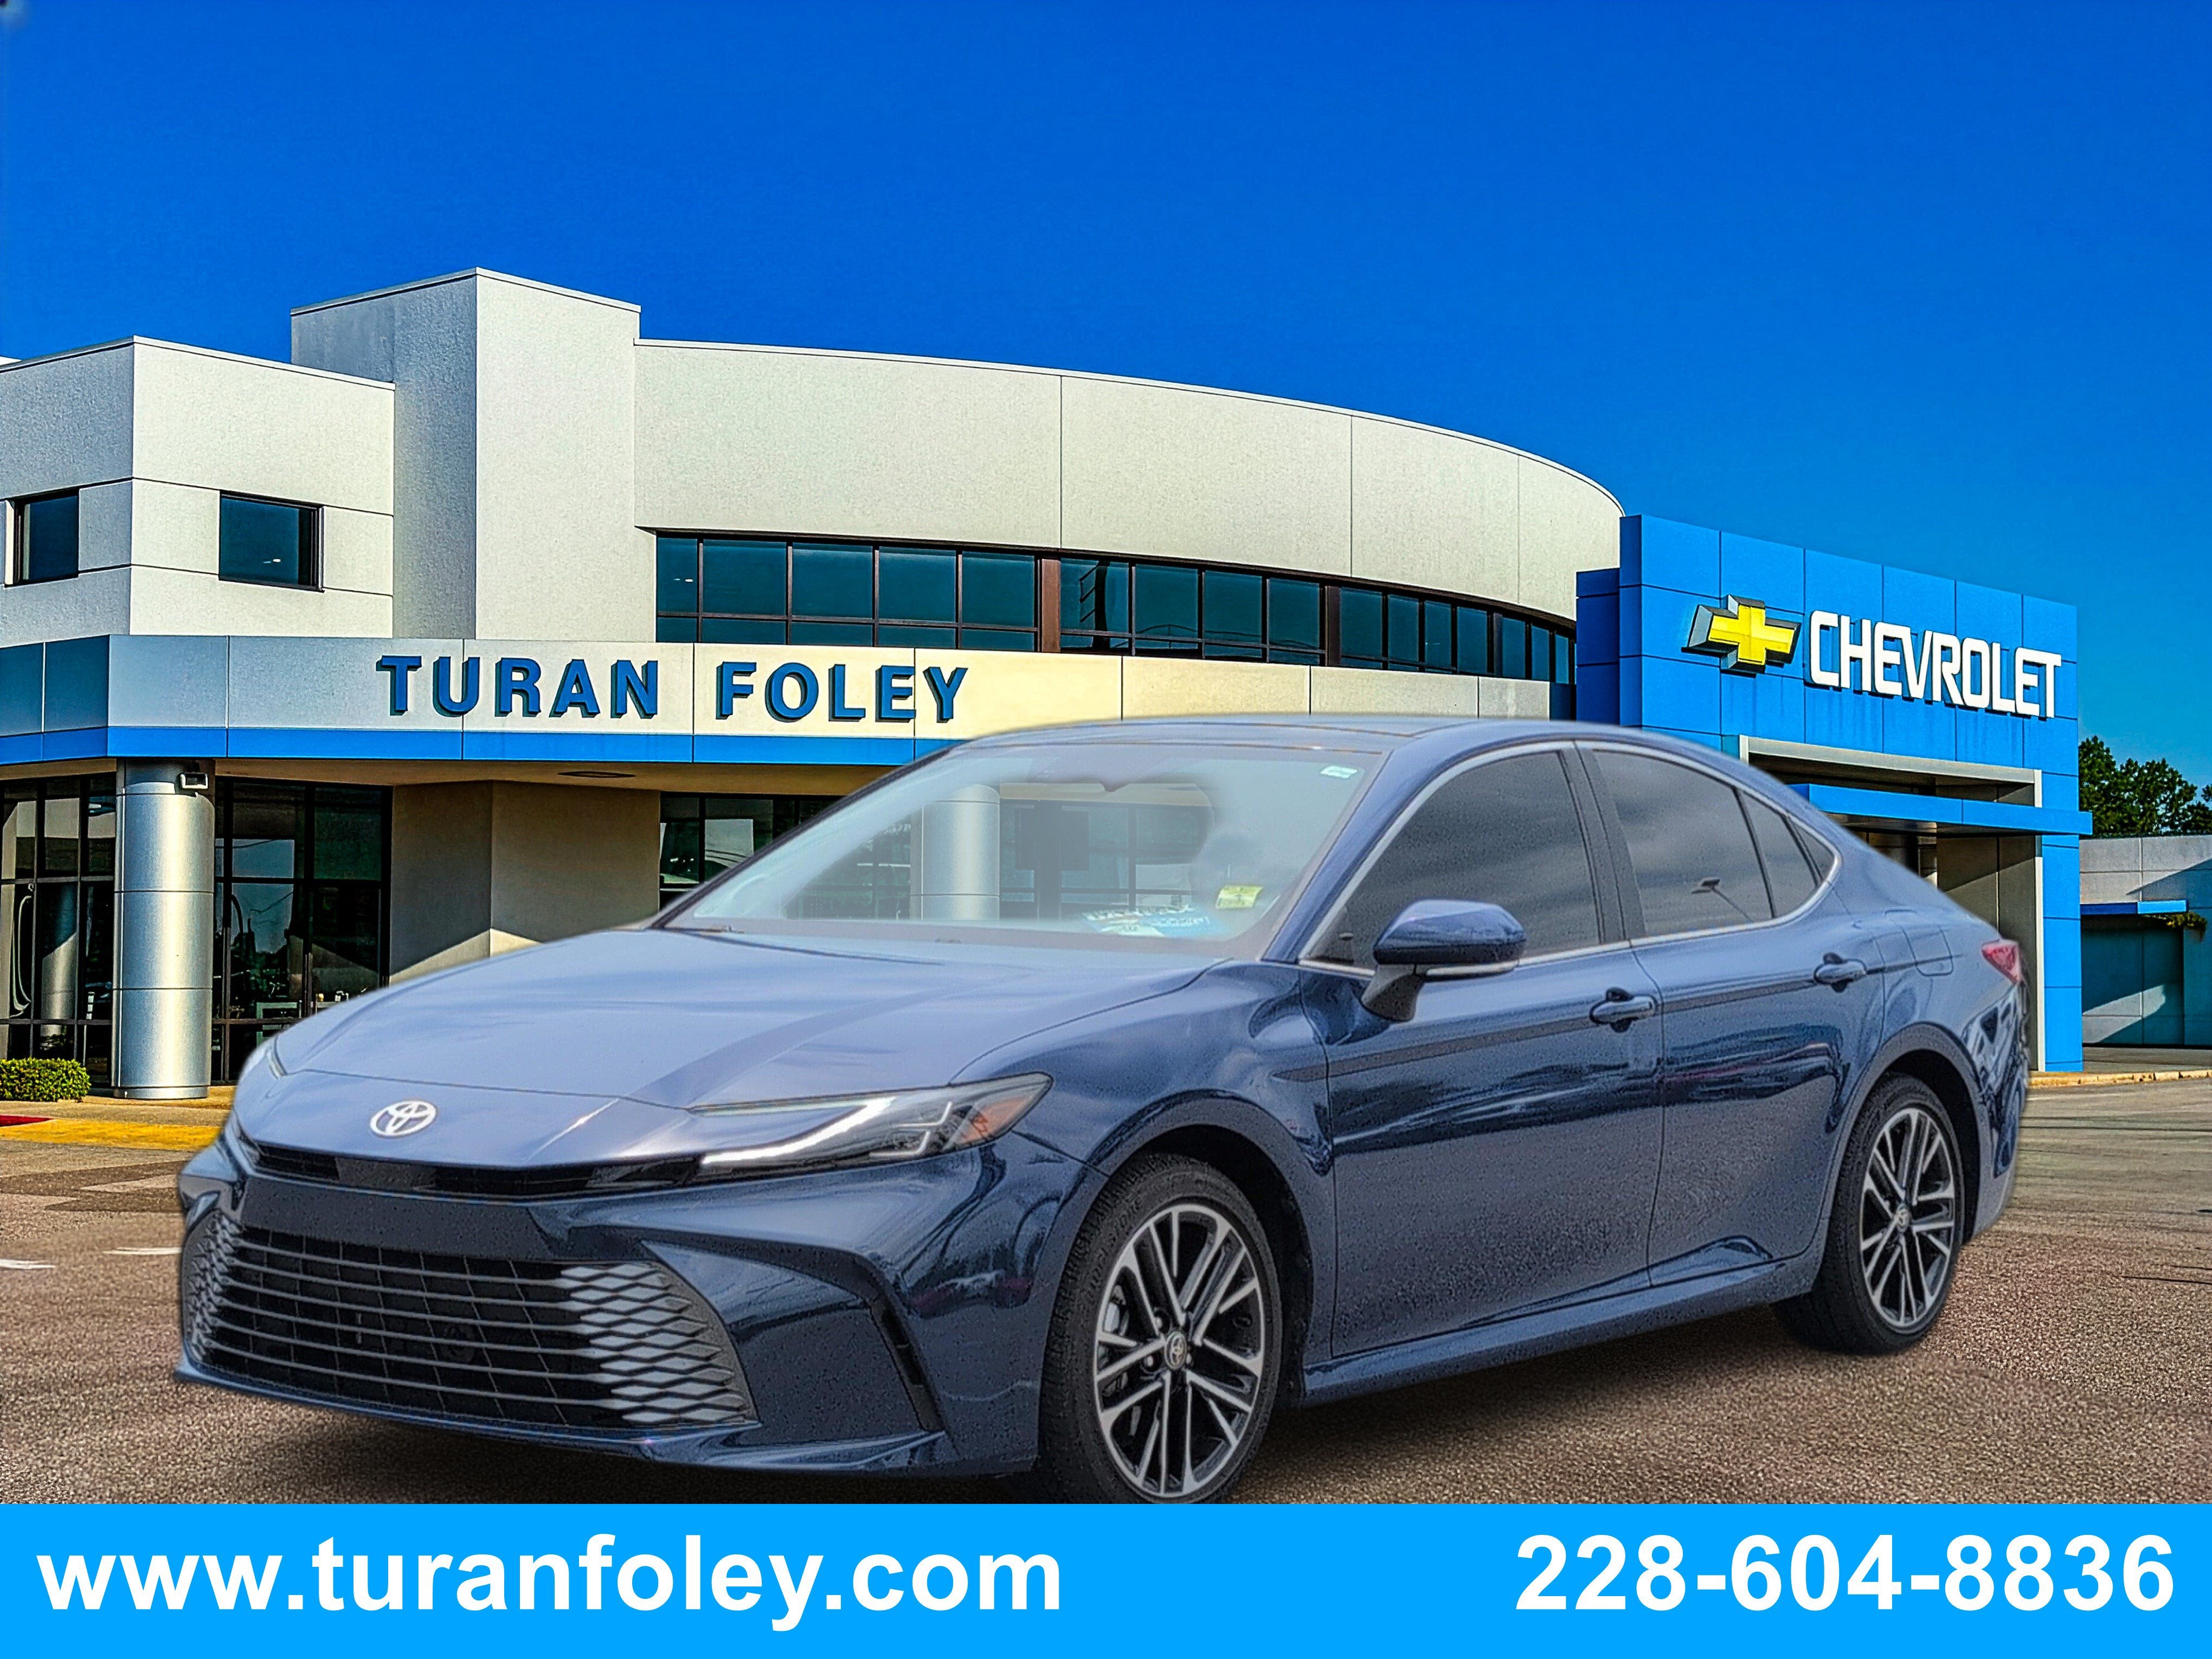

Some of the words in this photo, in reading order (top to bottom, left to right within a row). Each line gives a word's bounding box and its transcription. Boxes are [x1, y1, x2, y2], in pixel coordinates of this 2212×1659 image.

[376, 655, 659, 718] TURAN
[716, 661, 968, 723] FOLEY
[1810, 610, 2062, 719] CHEVROLET
